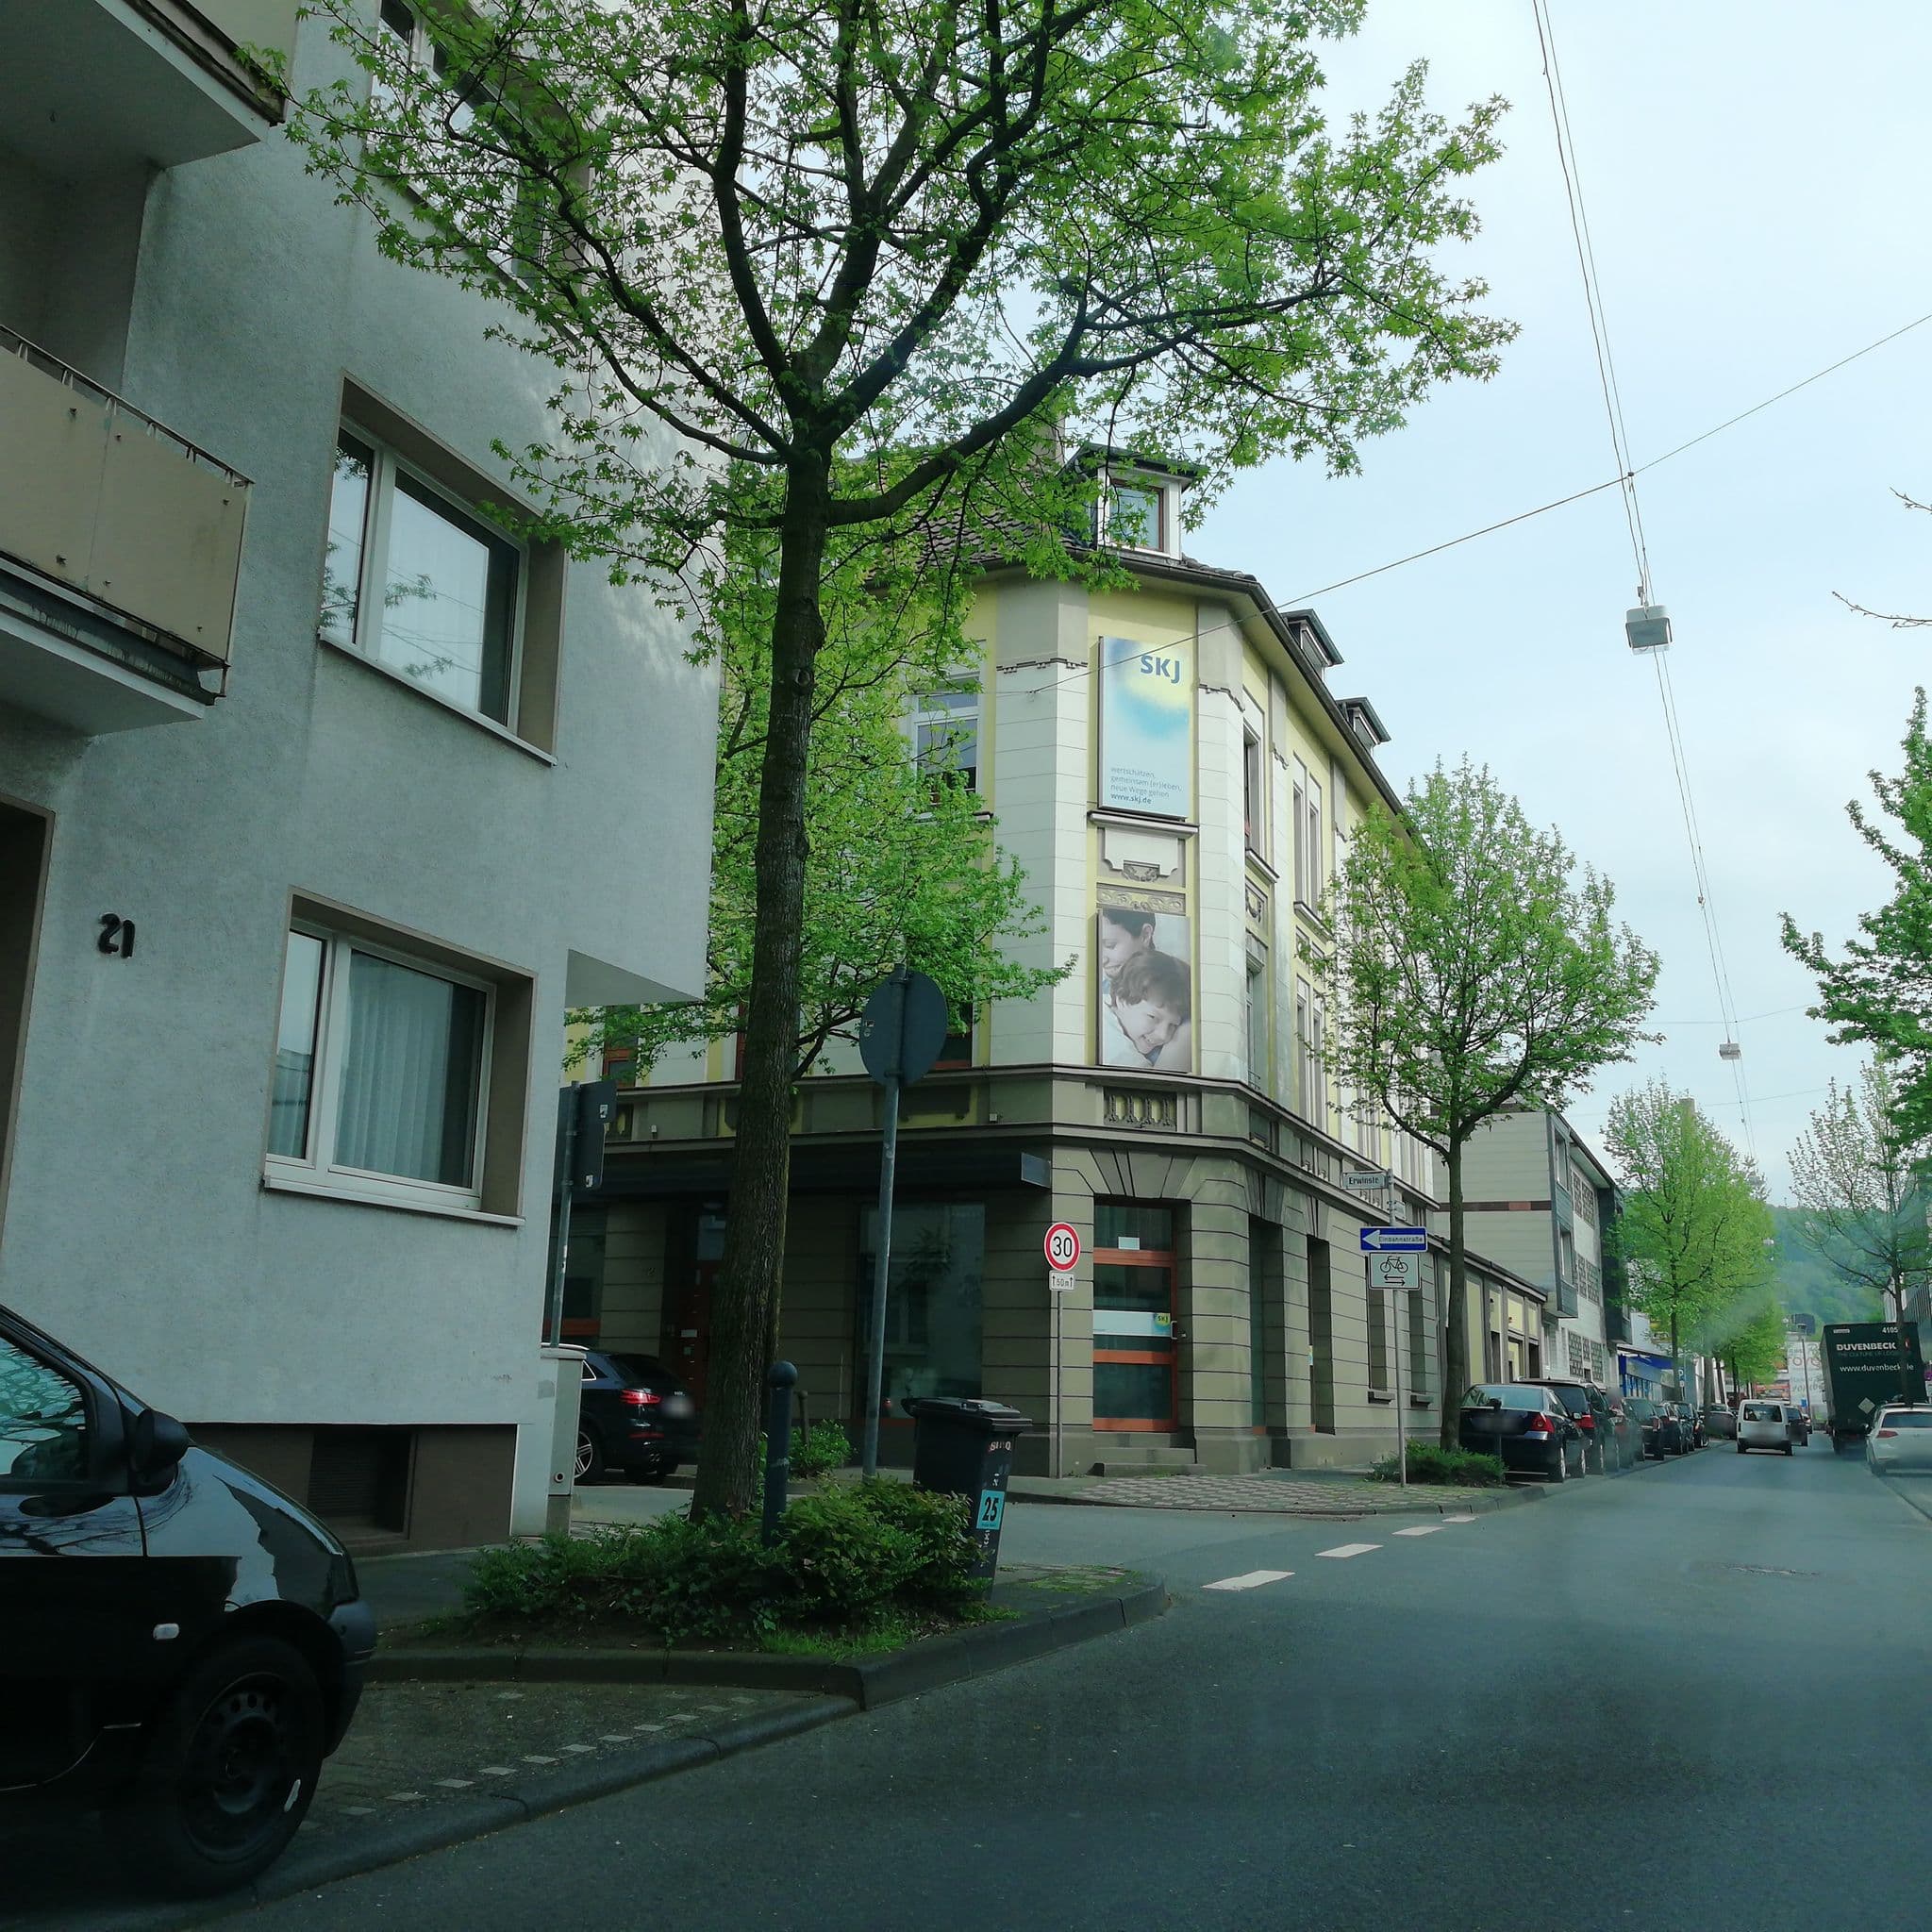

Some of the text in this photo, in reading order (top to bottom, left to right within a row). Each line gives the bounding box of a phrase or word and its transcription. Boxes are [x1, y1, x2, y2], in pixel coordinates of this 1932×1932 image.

[1141, 655, 1180, 684] SKJ
[1110, 775, 1149, 787] gemeinsam
[1110, 784, 1170, 799] neue Wege gehen
[1110, 793, 1153, 804] www.skj.de
[98, 913, 135, 959] 21
[1053, 1236, 1073, 1257] 30
[982, 1497, 999, 1522] 25
